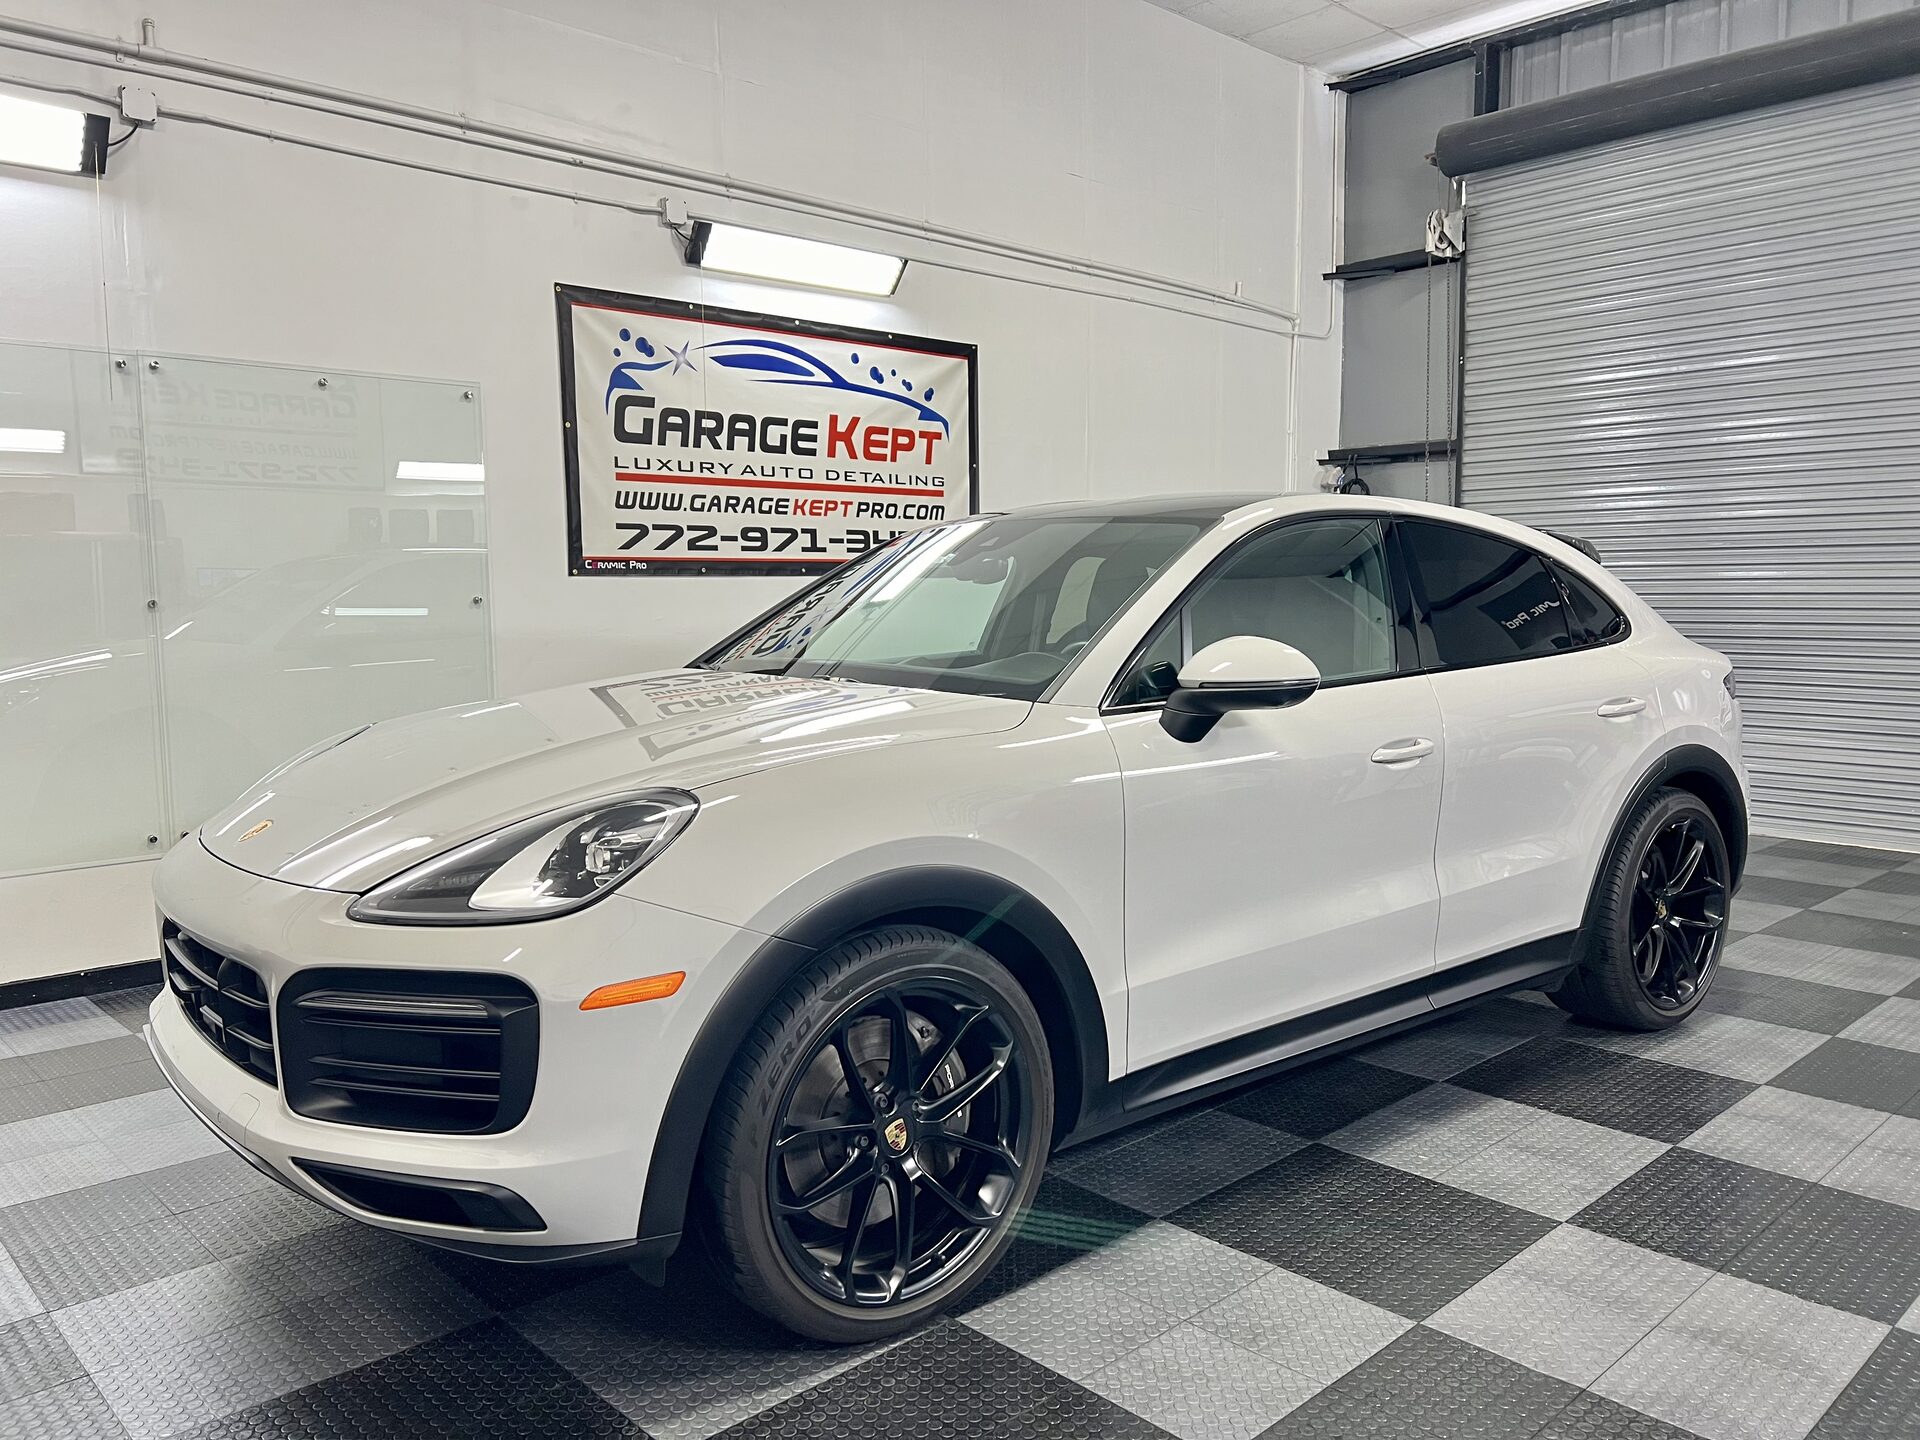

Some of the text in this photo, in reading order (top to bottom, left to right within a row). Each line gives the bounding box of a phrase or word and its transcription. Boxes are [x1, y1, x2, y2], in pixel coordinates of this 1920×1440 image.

[613, 394, 942, 465] GARAGE KEPT
[614, 455, 945, 487] LUXURY AUTO DETAILING
[615, 522, 910, 553] 772-971-34
